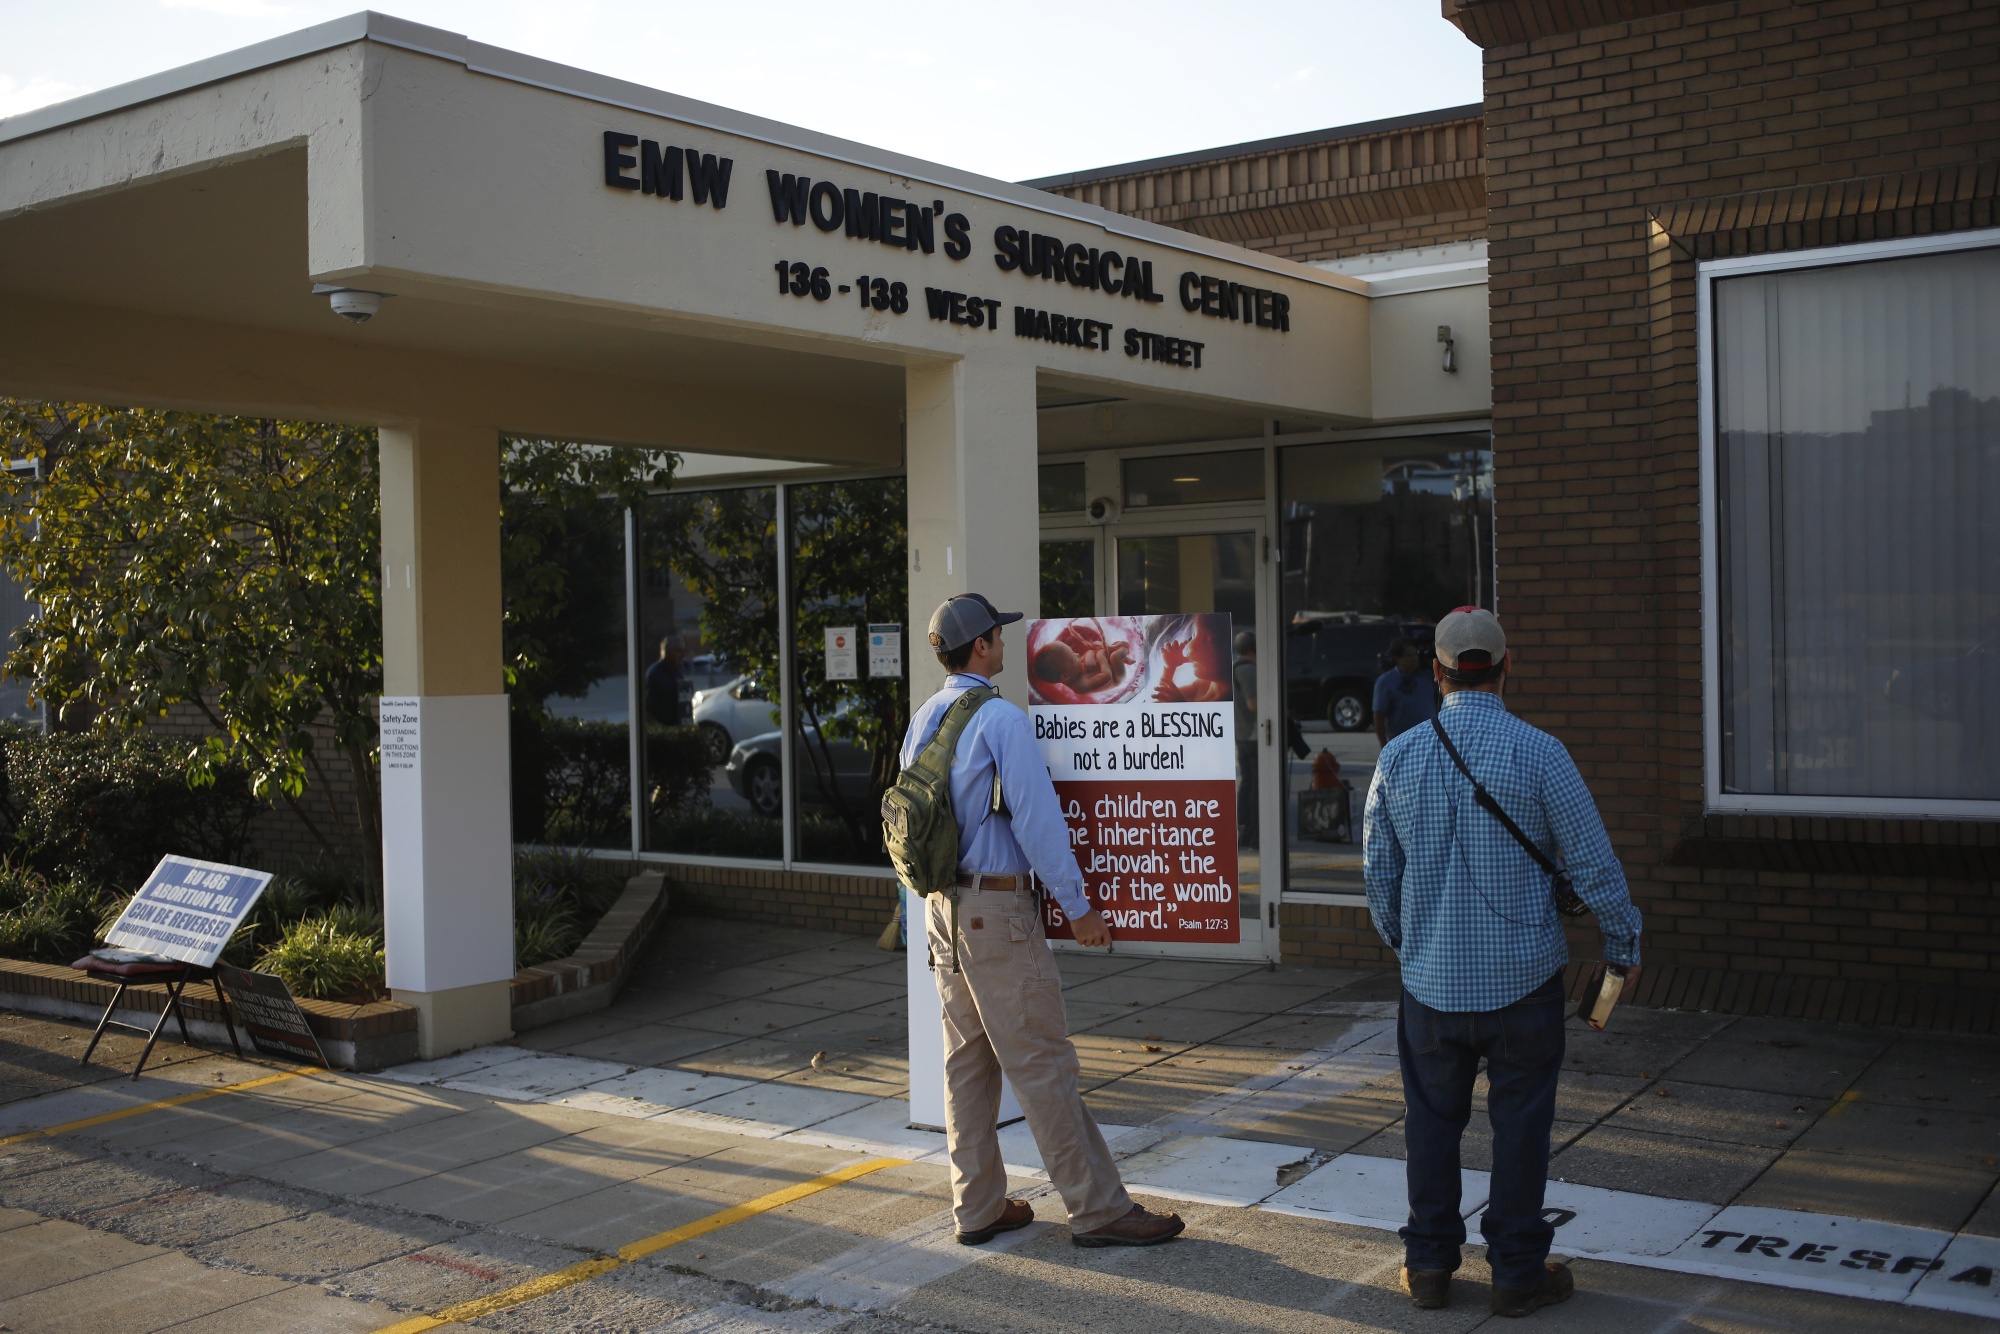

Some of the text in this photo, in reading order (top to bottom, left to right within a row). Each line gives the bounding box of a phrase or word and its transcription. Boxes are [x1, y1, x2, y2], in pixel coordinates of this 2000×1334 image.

[603, 130, 1291, 332] EMW WOMEN'S SURGICAL CENTER
[925, 286, 1002, 330] WEST
[1014, 305, 1113, 351] MARKET
[1124, 327, 1205, 369] STREET
[382, 714, 418, 724] Safety Zone
[1035, 712, 1224, 740] Babies are a BLESSING
[1073, 744, 1185, 770] not a burden!
[1094, 791, 1177, 818] children
[1184, 798, 1221, 818] are
[1097, 821, 1216, 847] inheritance
[1084, 848, 1217, 874] Jehovah; the
[183, 869, 231, 890] RU 486
[1098, 876, 1121, 901] of
[1129, 876, 1166, 901] the
[1173, 875, 1232, 903] womb
[151, 882, 239, 914] ABORTION PILL
[128, 902, 232, 938] CAN BE REVERSED
[1047, 902, 1063, 926] is
[1178, 918, 1202, 930] Psalm
[1204, 918, 1229, 930] 127:3
